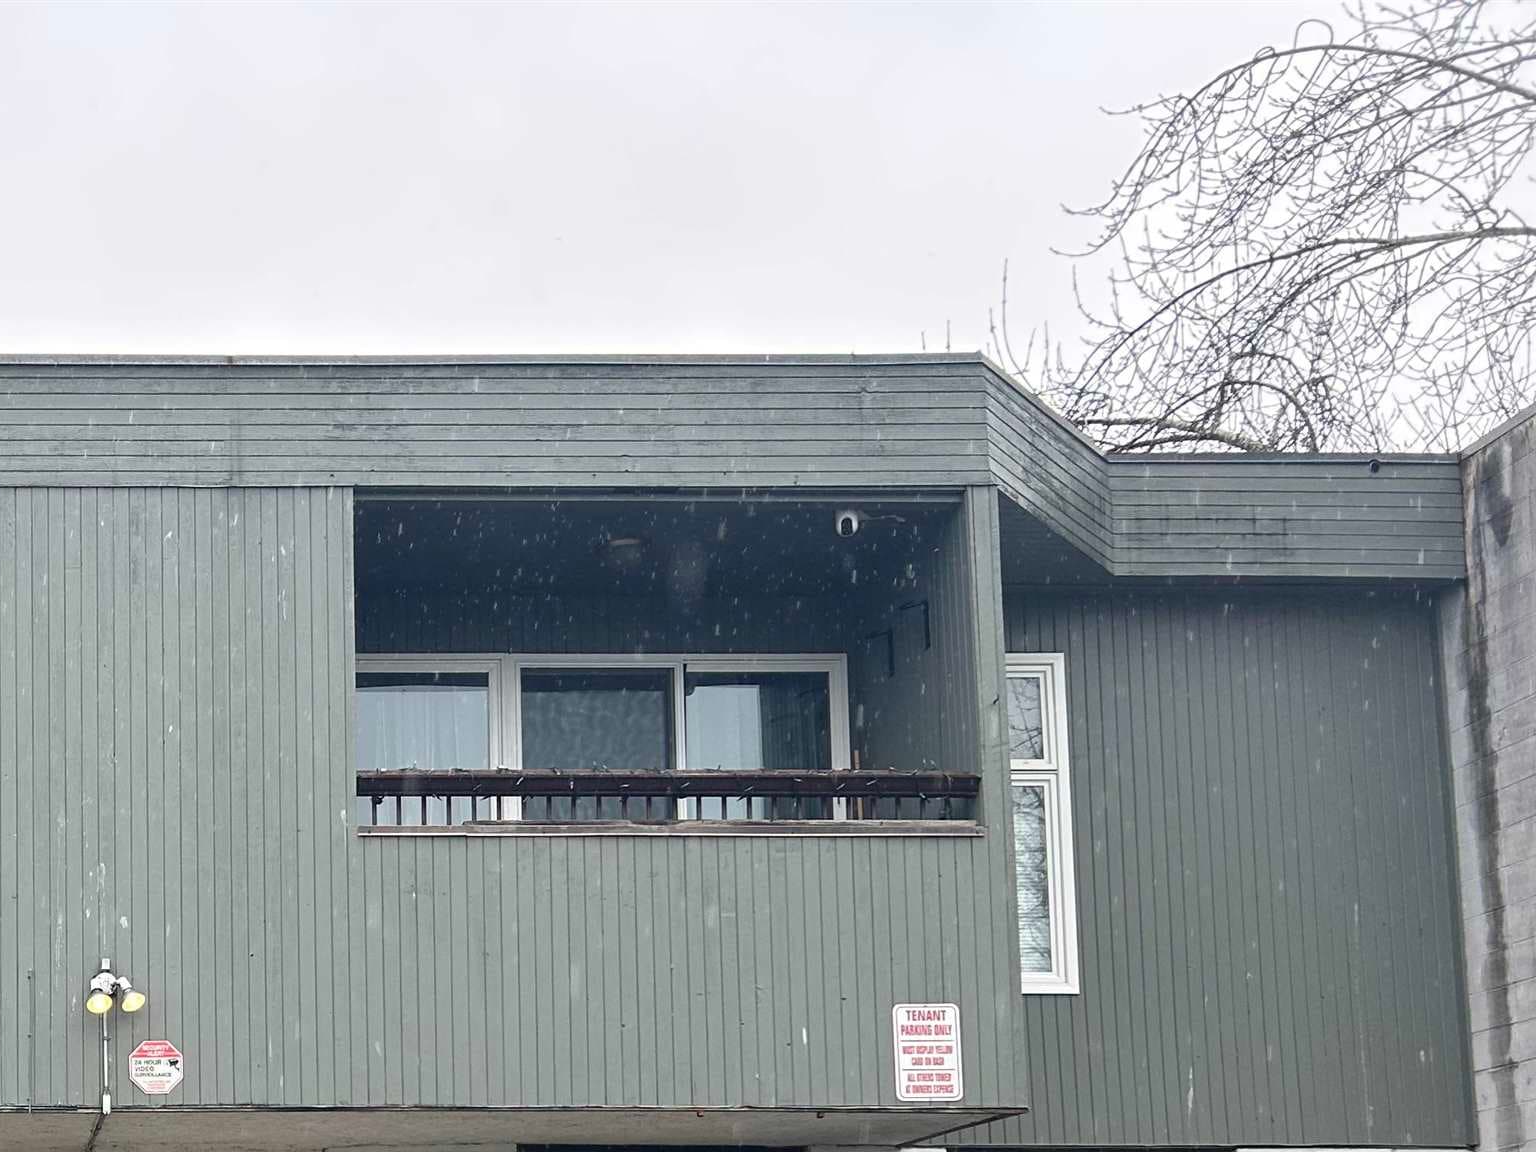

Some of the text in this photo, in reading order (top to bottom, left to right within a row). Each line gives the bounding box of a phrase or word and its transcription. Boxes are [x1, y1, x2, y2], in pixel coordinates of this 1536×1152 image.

[906, 1010, 946, 1021] TENANT
[901, 1025, 952, 1036] PARKING ONLY
